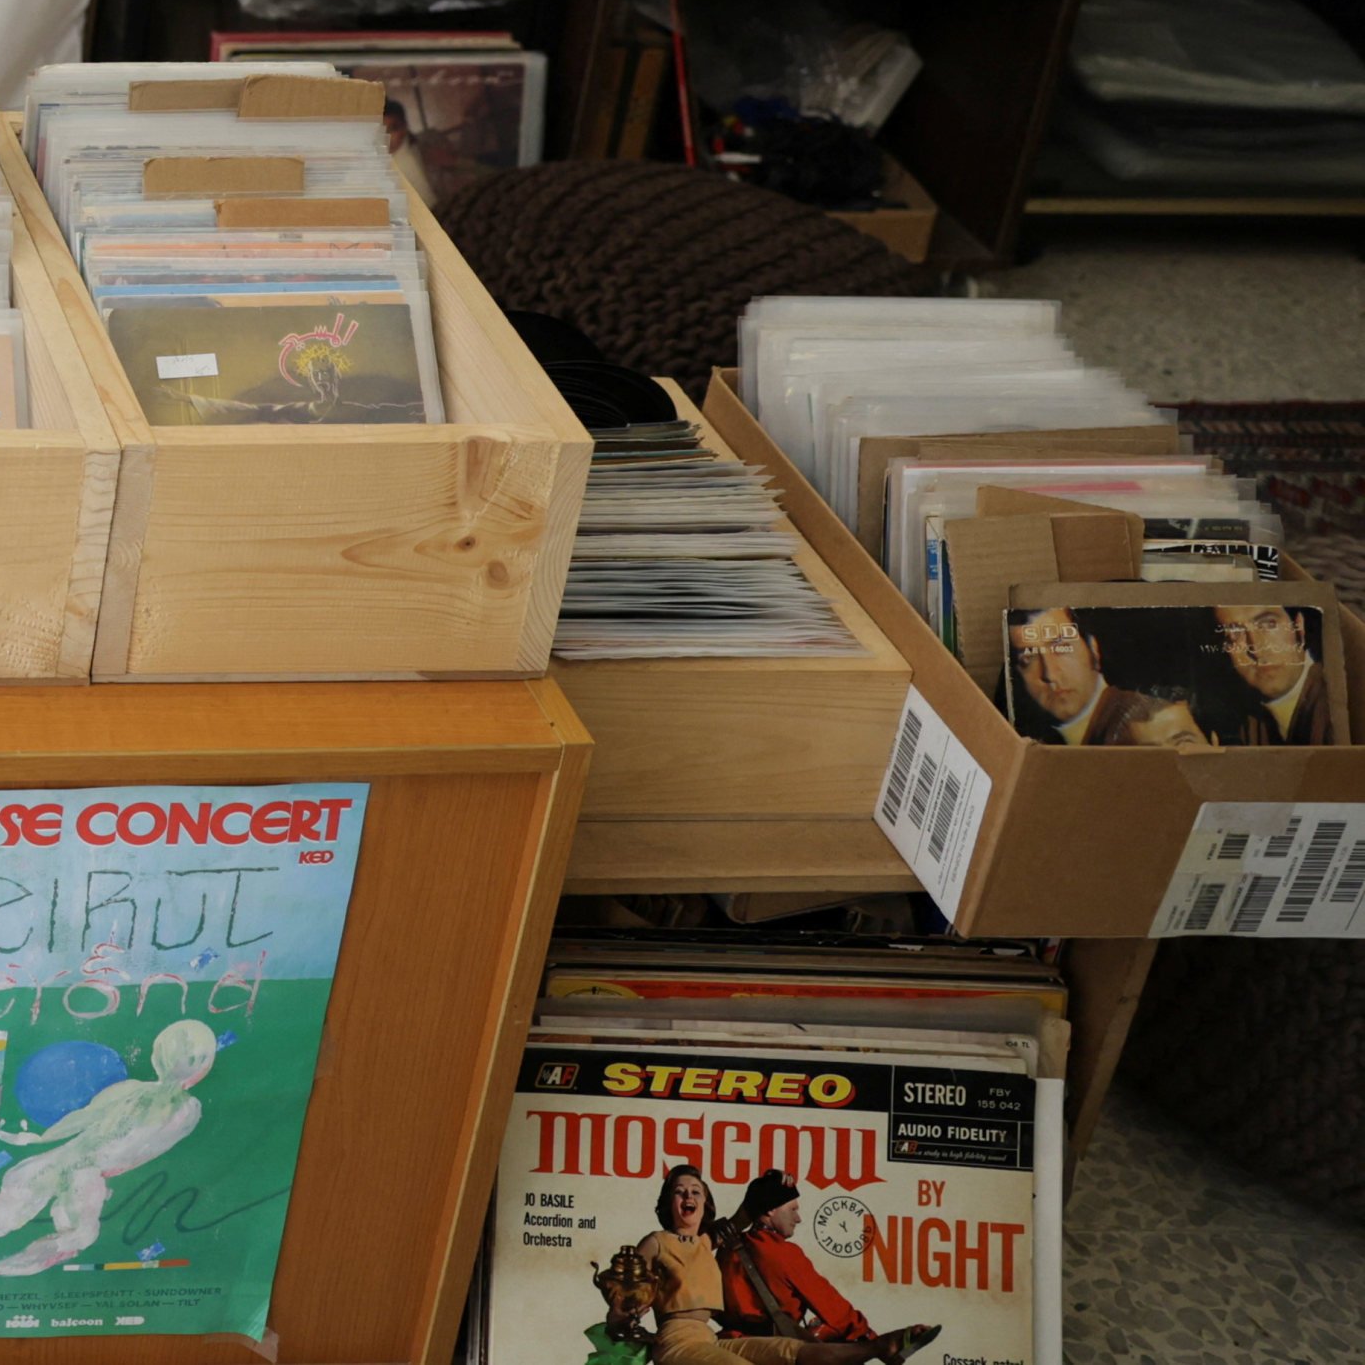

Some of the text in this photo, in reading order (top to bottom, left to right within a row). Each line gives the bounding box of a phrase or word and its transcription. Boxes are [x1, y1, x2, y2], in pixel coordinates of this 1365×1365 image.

[74, 797, 354, 846] CONCERT
[297, 849, 335, 865] KED
[602, 1061, 856, 1109] STEREO
[903, 1081, 1012, 1107] STEREO FBY
[977, 1099, 1022, 1112] 155 042
[897, 1122, 1008, 1144] AUDIO FIDELITY
[523, 1192, 575, 1210] JO BASILE
[917, 1179, 947, 1208] BY
[523, 1212, 597, 1230] Accordion and
[817, 1200, 866, 1227] МОСКВА
[523, 1231, 573, 1249] Orchestra
[860, 1213, 1026, 1293] NIGHT
[143, 1286, 223, 1299] SUNDOWNER
[176, 1297, 202, 1308] TILT
[49, 1316, 104, 1329] balcoon
